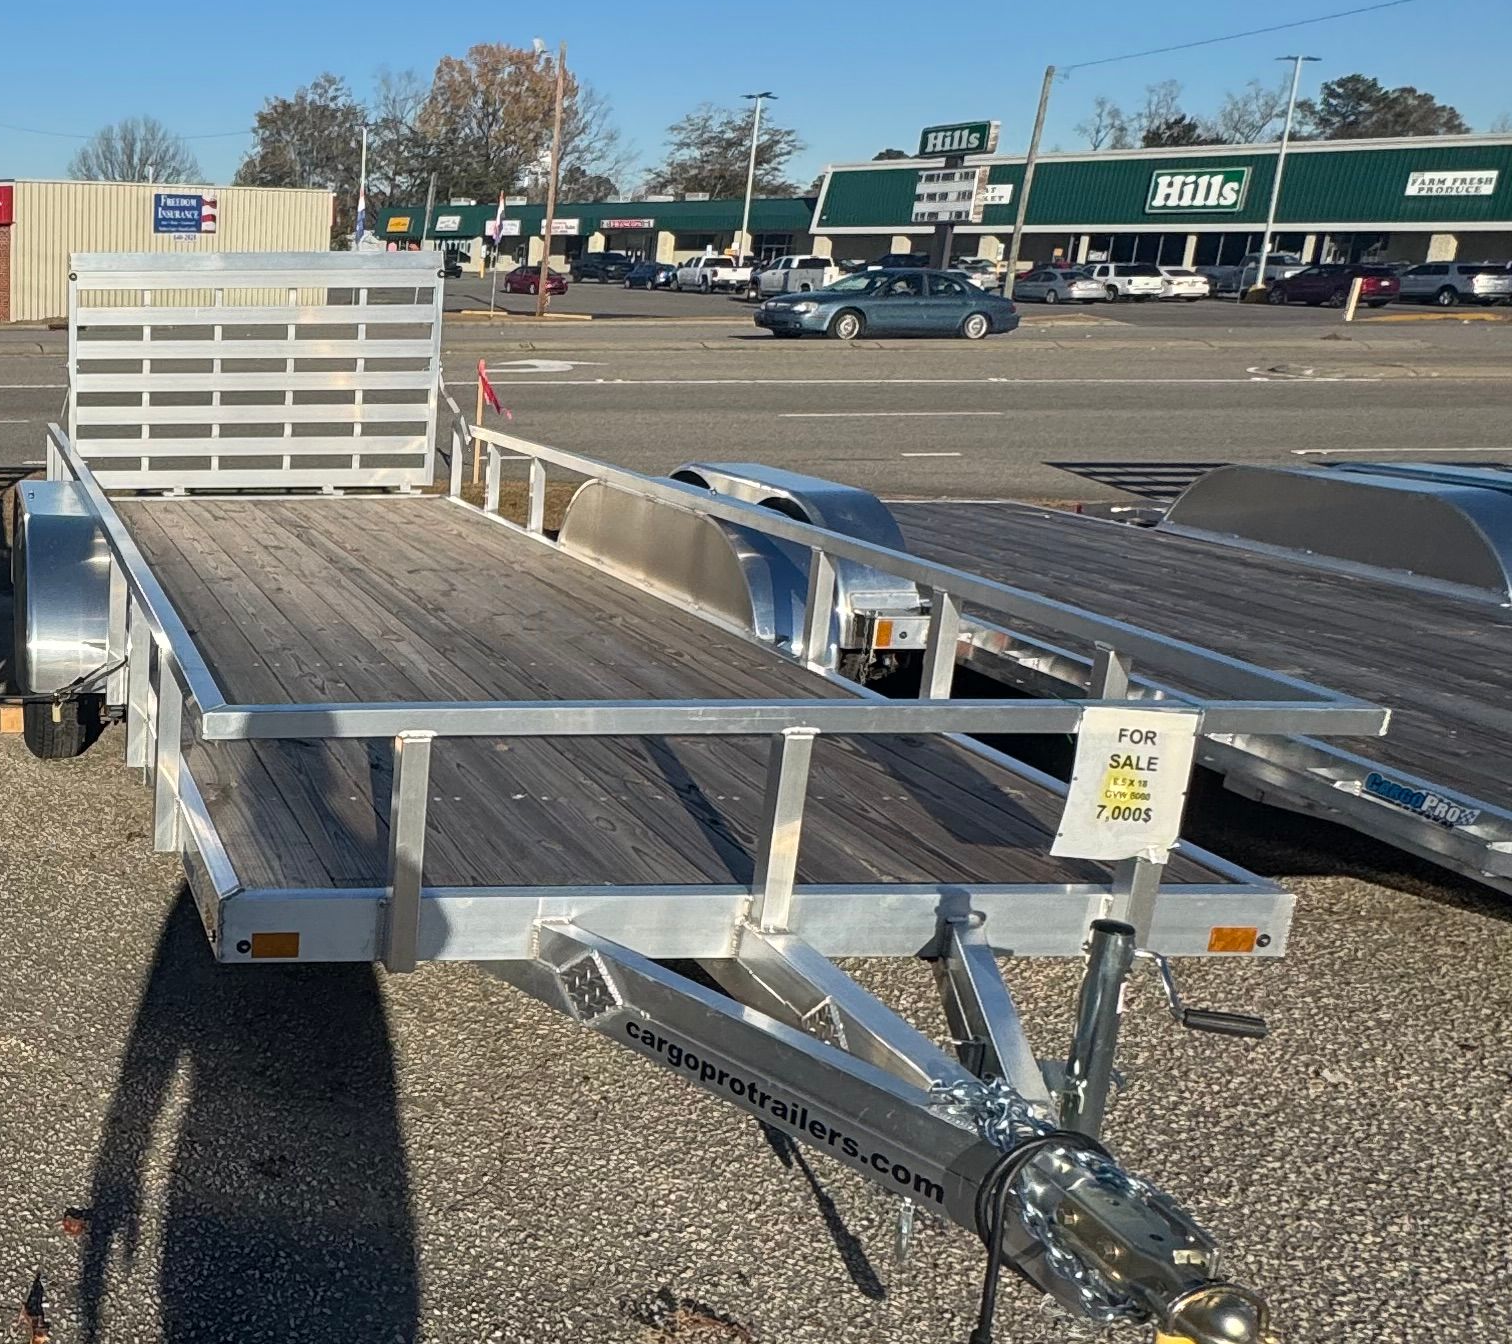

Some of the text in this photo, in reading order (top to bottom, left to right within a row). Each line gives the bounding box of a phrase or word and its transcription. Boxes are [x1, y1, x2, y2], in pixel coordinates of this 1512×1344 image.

[925, 129, 981, 152] Hills
[1151, 174, 1240, 207] Hills
[1410, 177, 1494, 186] FARM FRESH
[1417, 186, 1482, 194] PRODUCE
[160, 195, 197, 207] FREEDOM
[158, 207, 200, 219] INSURANCE
[1118, 727, 1157, 745] FOR
[1109, 754, 1159, 772] SALE
[1096, 804, 1153, 823] 7,000$
[625, 1019, 945, 1204] cargoprotrailers.com
